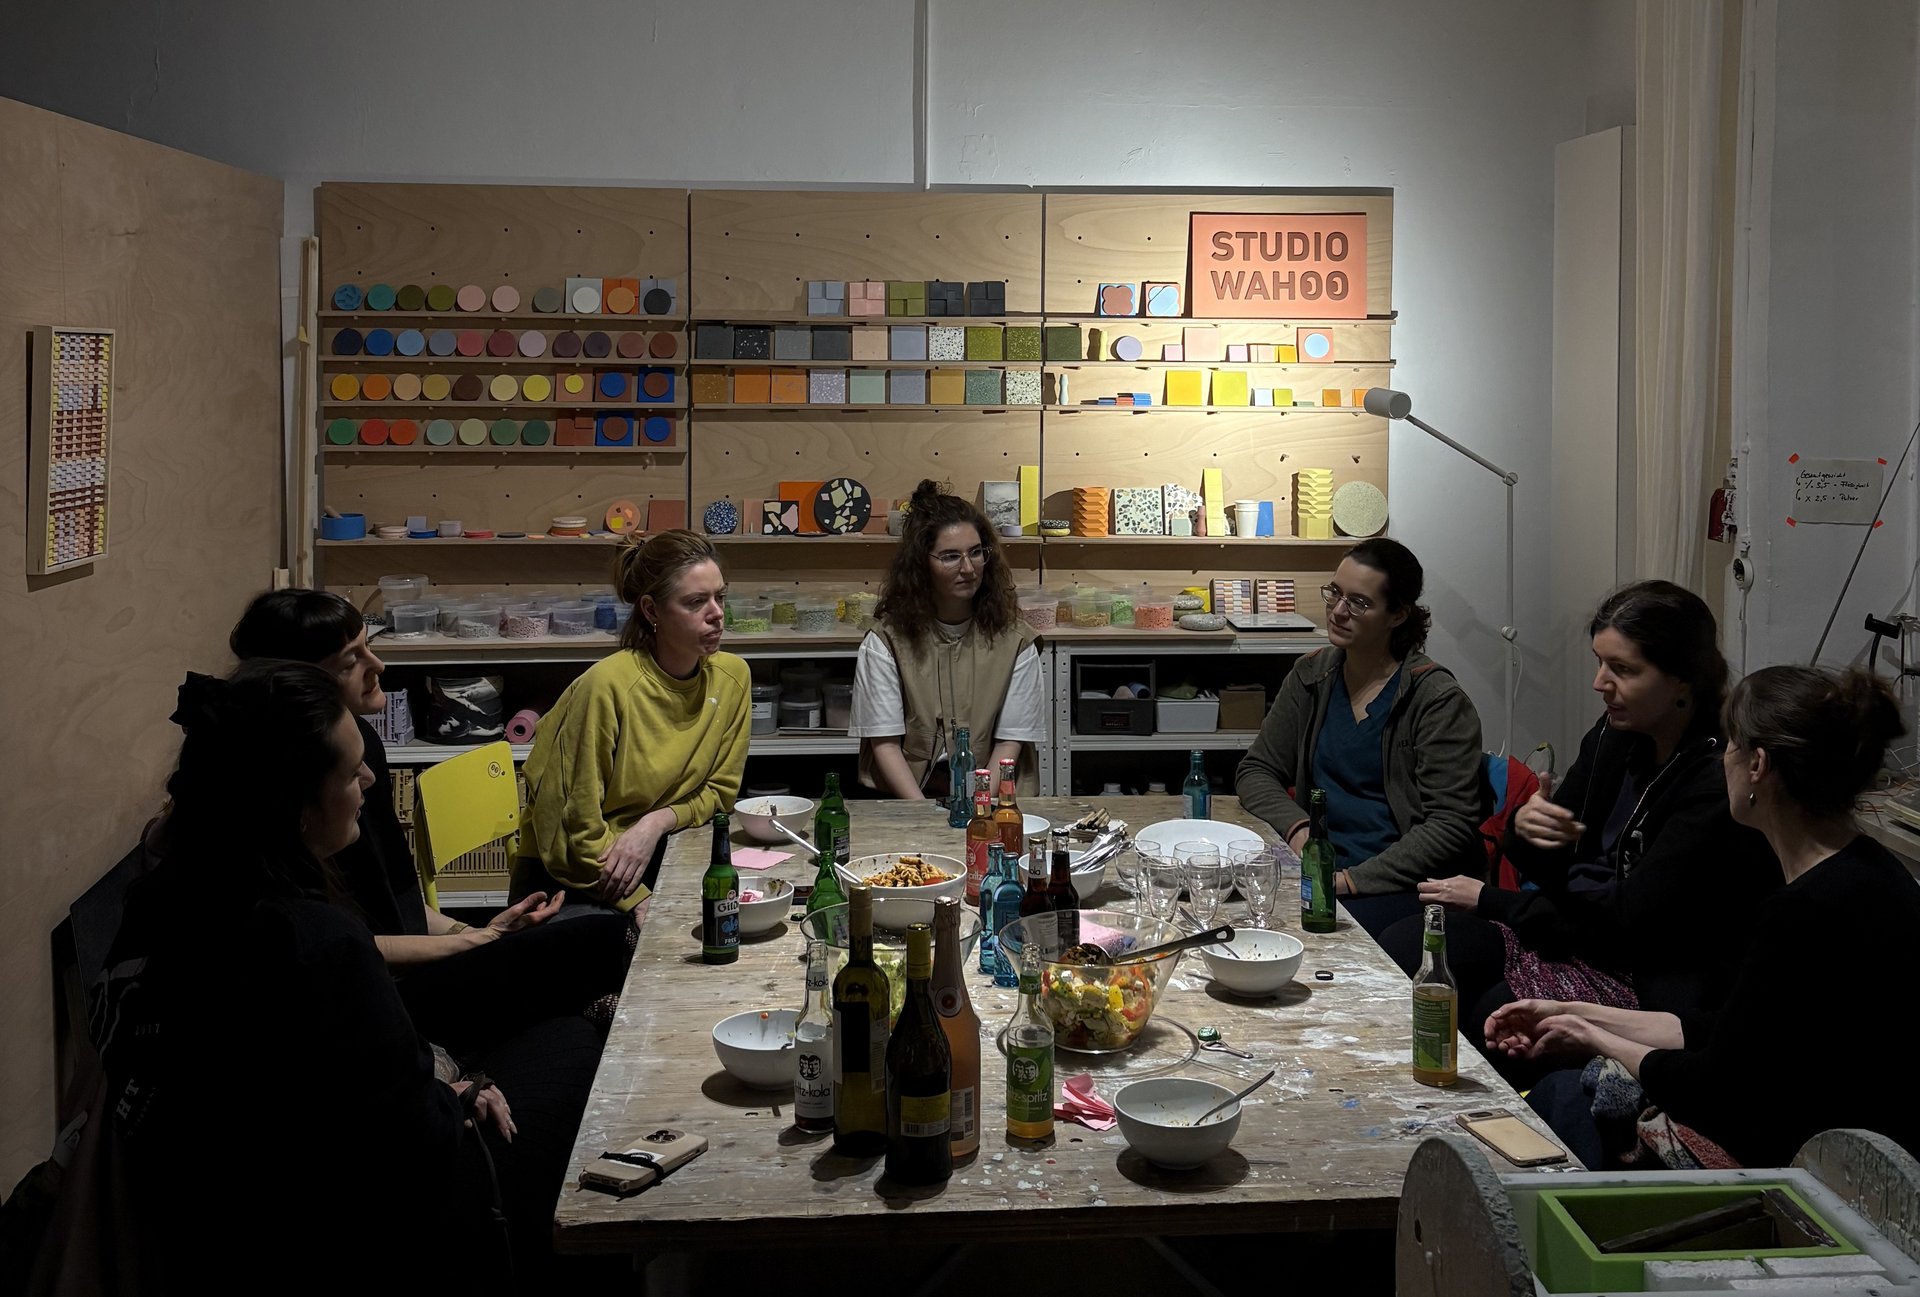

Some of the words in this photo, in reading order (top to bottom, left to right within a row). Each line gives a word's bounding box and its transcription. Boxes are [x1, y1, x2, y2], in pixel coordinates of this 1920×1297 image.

[1211, 231, 1349, 262] STUDIO
[1210, 271, 1349, 301] WAHOO
[794, 1079, 831, 1098] itz-kola
